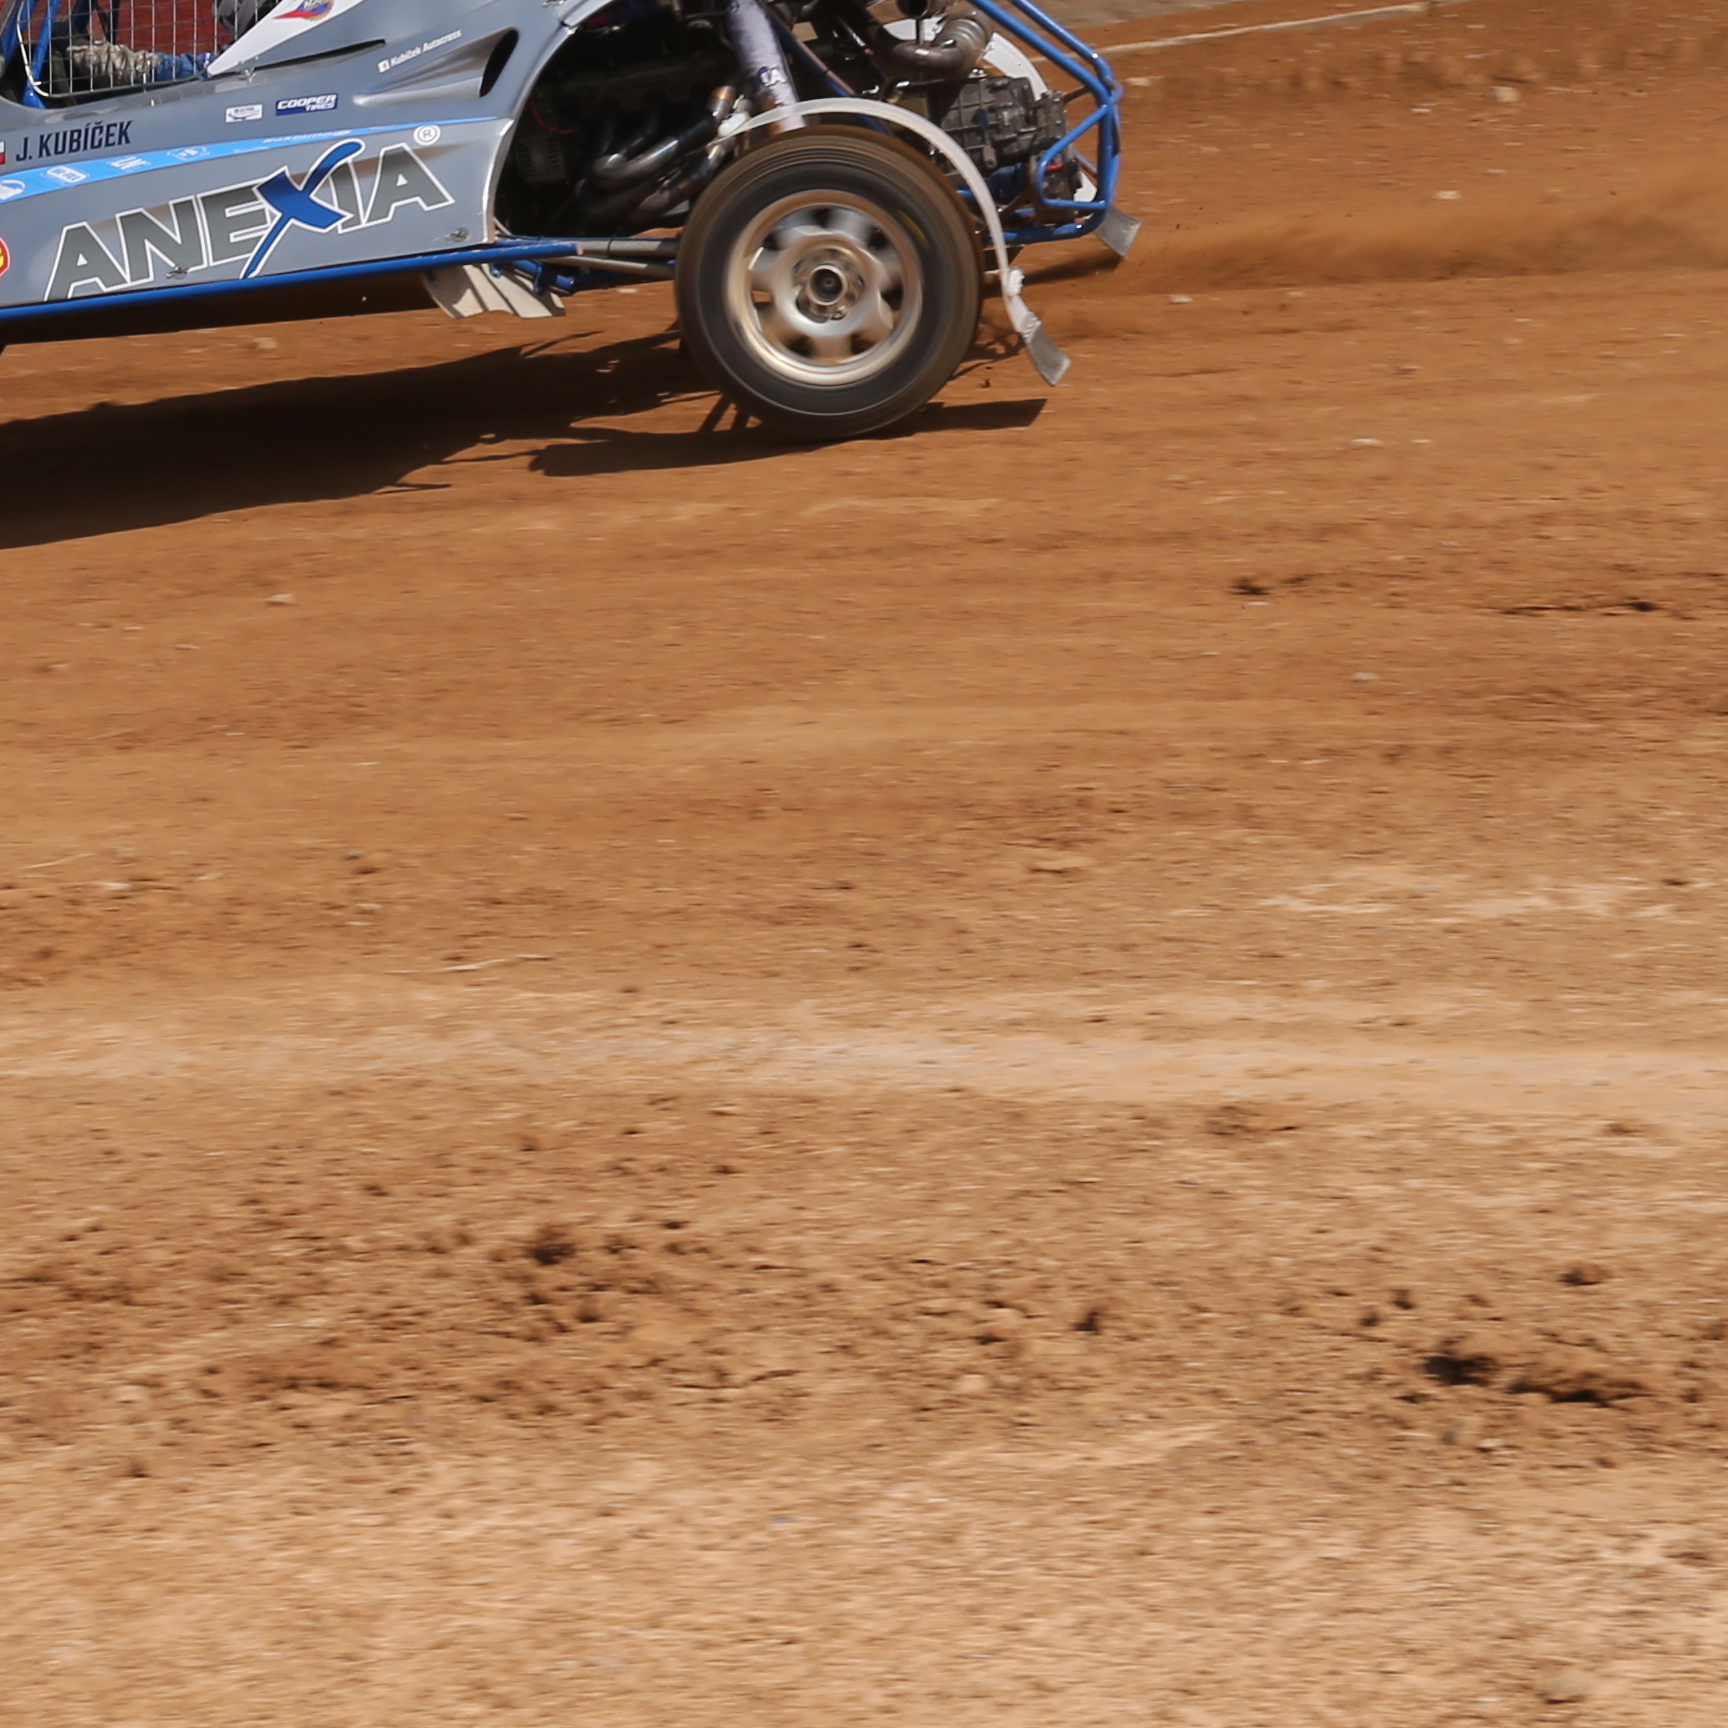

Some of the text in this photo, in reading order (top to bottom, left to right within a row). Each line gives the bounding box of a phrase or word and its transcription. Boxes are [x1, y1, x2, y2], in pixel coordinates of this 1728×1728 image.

[277, 94, 337, 110] COOPER
[305, 103, 335, 112] TIRES
[16, 142, 32, 162] J.
[38, 120, 132, 159] KUBÍČEK
[44, 138, 455, 301] ANEXIA
